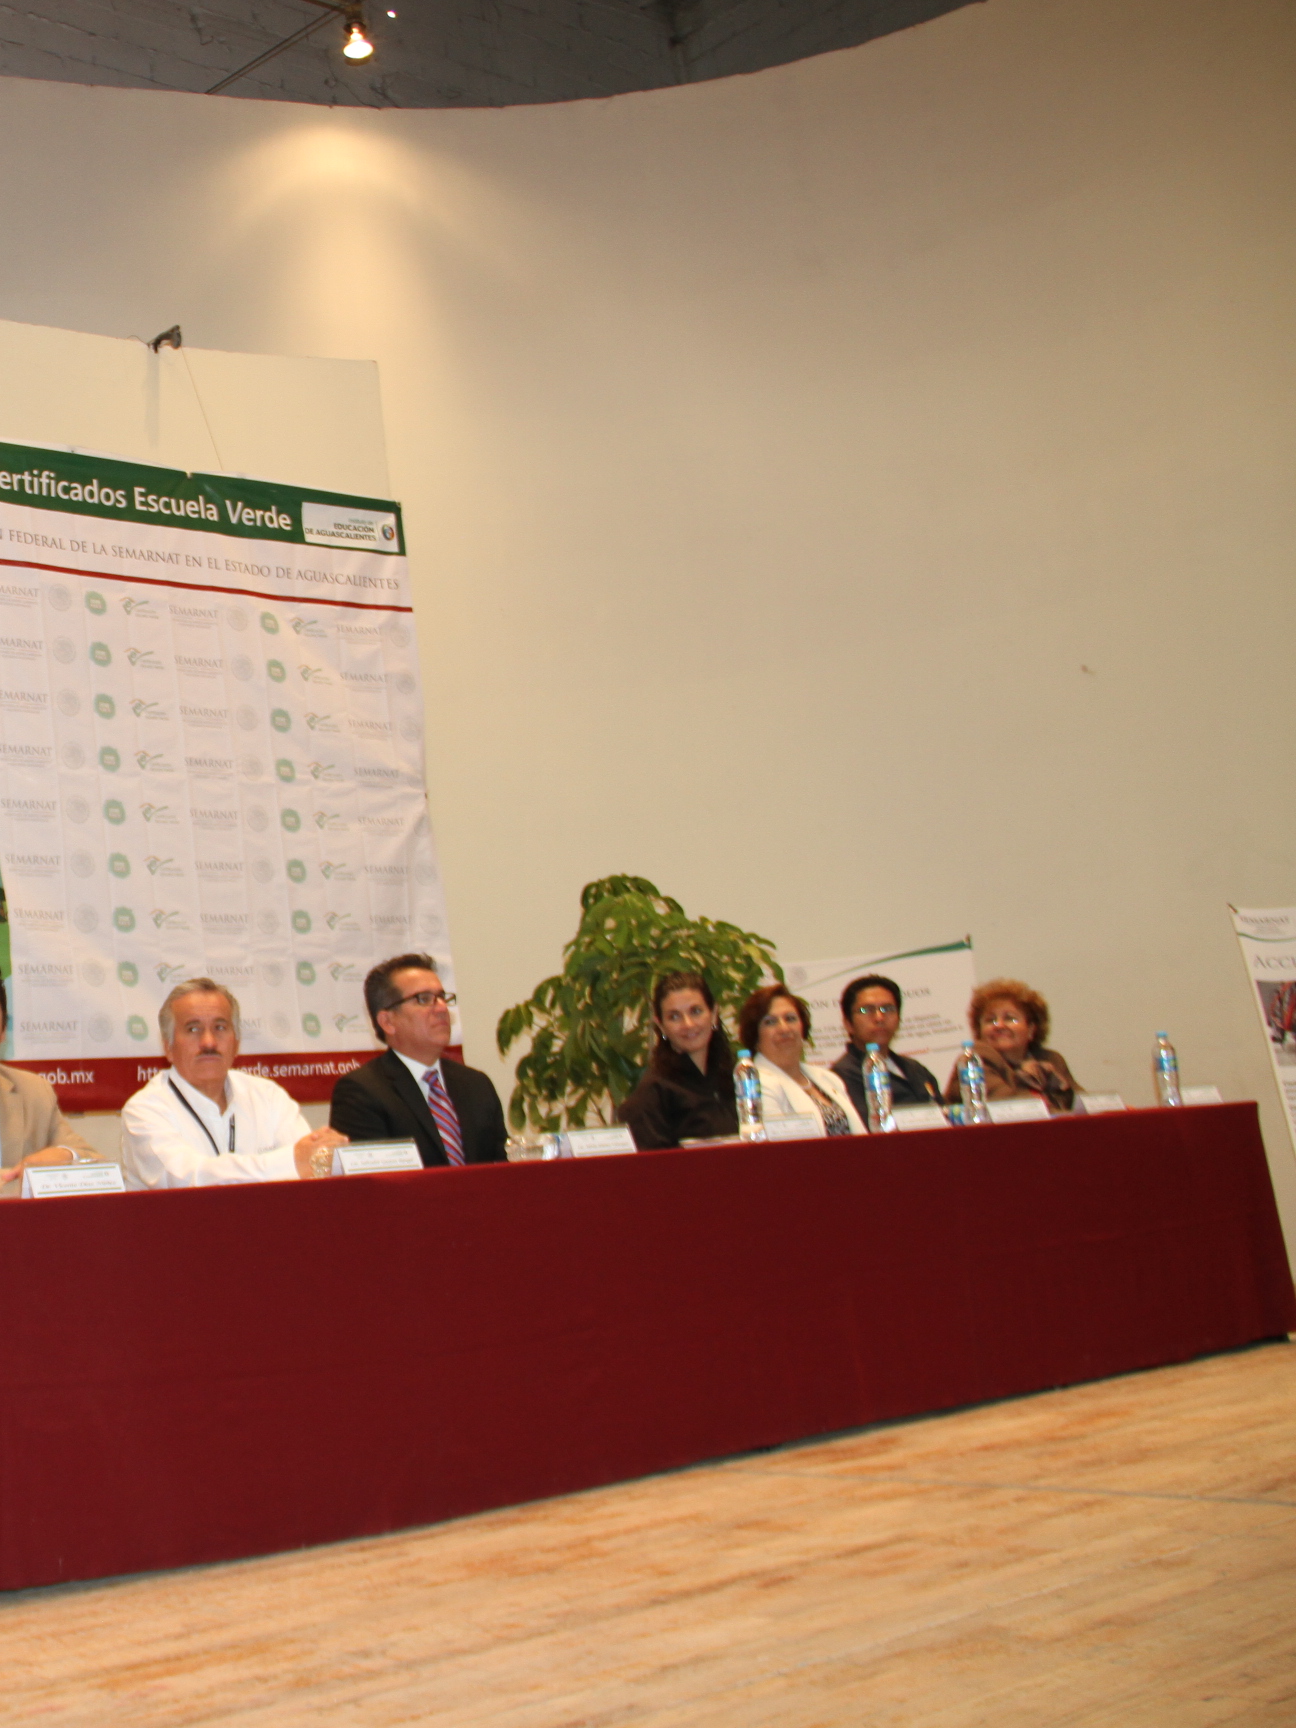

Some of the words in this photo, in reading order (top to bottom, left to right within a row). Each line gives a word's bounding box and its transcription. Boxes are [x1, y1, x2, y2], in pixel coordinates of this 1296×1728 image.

[134, 487, 219, 523] Escuela
[225, 500, 294, 531] Verde
[304, 527, 314, 535] DE
[315, 529, 377, 541] AGUASCALIENTES
[333, 522, 375, 533] EDUCACIÓN
[9, 529, 66, 550] FEDERAL
[70, 540, 88, 554] DE
[92, 543, 109, 557] LA
[111, 545, 180, 566] SEMARNAT
[185, 554, 203, 568] EN
[207, 556, 223, 570] EL
[225, 559, 271, 578] ESTADO
[276, 566, 293, 580] DE
[295, 569, 400, 591] AGUASCALIENTES
[0, 798, 57, 812] SEMARNAT
[5, 853, 61, 867] SEMARNAT
[13, 908, 65, 922] SEMARNAT
[17, 962, 74, 977] SEMARNAT
[20, 1020, 78, 1034] SEMARNAT
